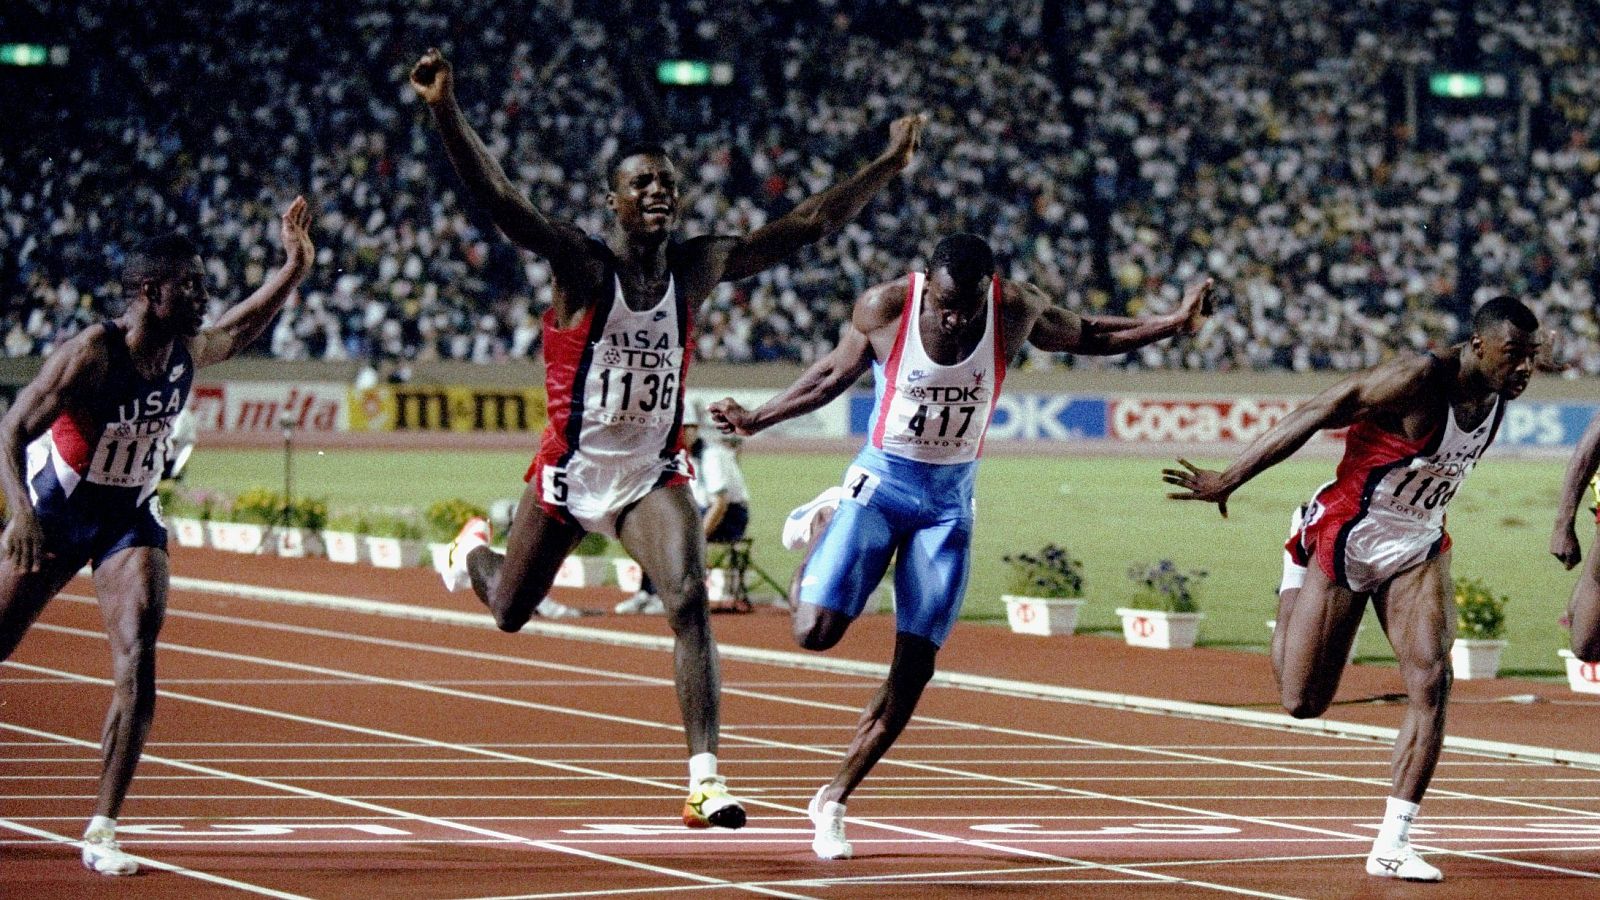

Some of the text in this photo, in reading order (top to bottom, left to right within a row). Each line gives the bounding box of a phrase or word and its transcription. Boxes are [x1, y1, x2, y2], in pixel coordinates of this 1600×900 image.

[622, 350, 672, 369] TDK
[119, 388, 181, 422] USA
[600, 368, 675, 412] 1136
[927, 386, 981, 402] TDK
[395, 392, 527, 430] mm
[907, 404, 976, 438] 417
[988, 394, 1077, 441] DK
[1112, 395, 1298, 443] Coca-Co
[553, 472, 568, 503] 5
